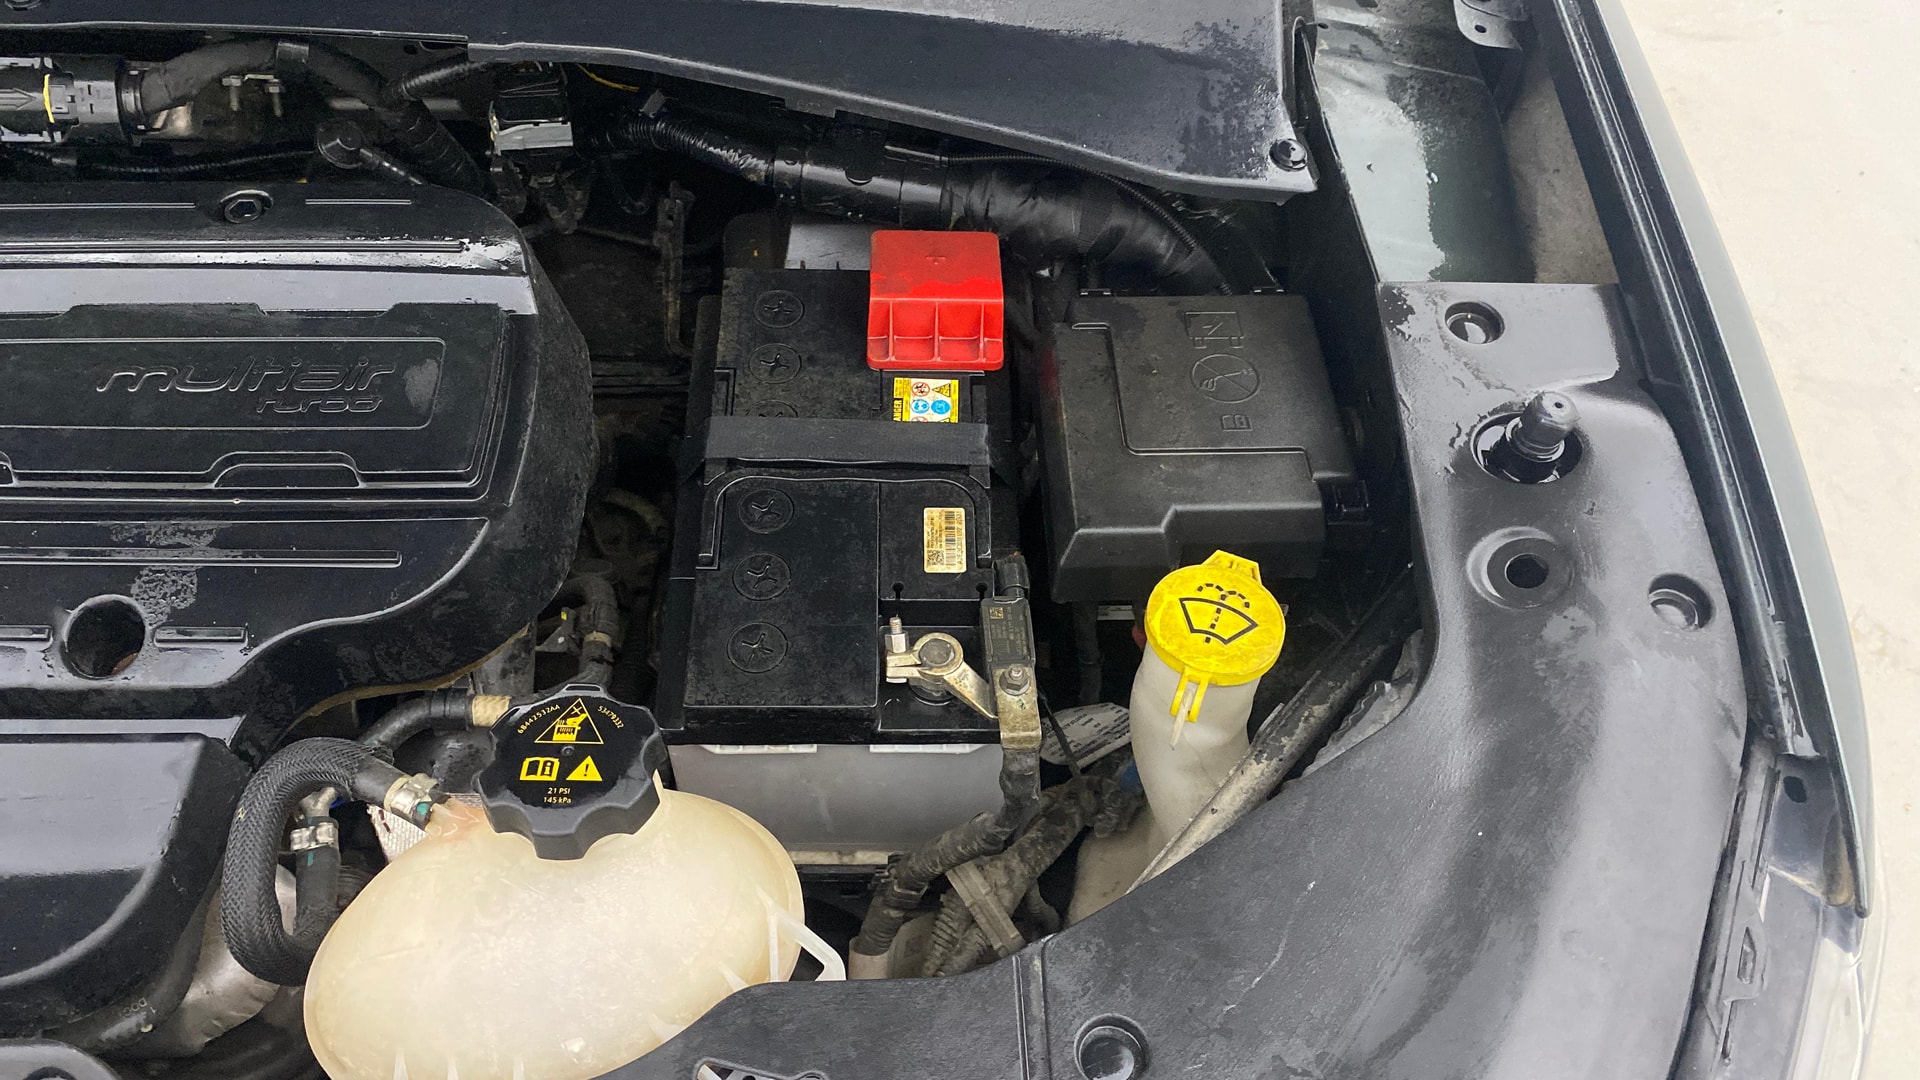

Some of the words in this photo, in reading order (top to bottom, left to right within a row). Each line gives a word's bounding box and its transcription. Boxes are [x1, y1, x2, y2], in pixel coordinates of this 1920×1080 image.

[96, 355, 396, 392] multiair
[257, 395, 383, 413] turbo
[893, 399, 902, 421] ANGER
[544, 796, 557, 804] 145
[558, 796, 572, 804] kPa
[547, 787, 557, 795] 21
[558, 787, 571, 795] PSI
